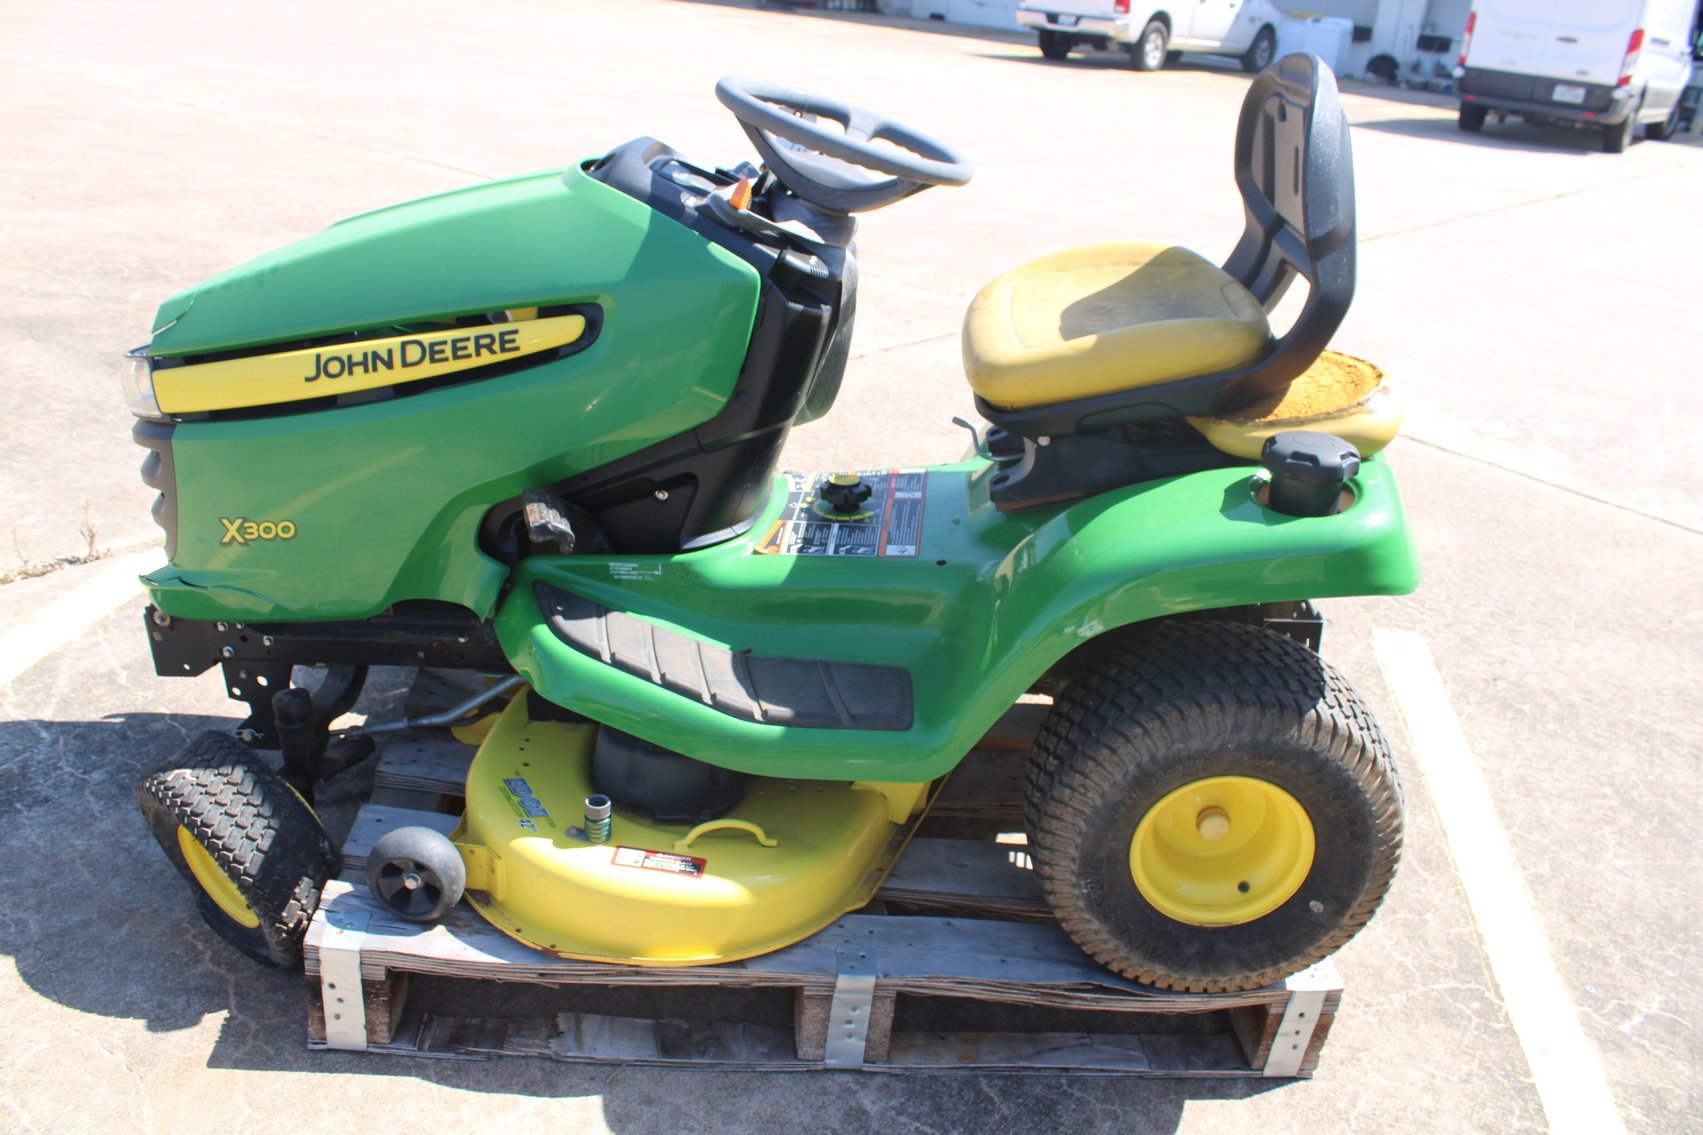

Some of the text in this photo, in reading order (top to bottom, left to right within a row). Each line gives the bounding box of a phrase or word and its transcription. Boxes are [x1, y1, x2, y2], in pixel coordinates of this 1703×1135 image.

[305, 330, 519, 382] JOHN DEERE
[220, 517, 296, 545] X300
